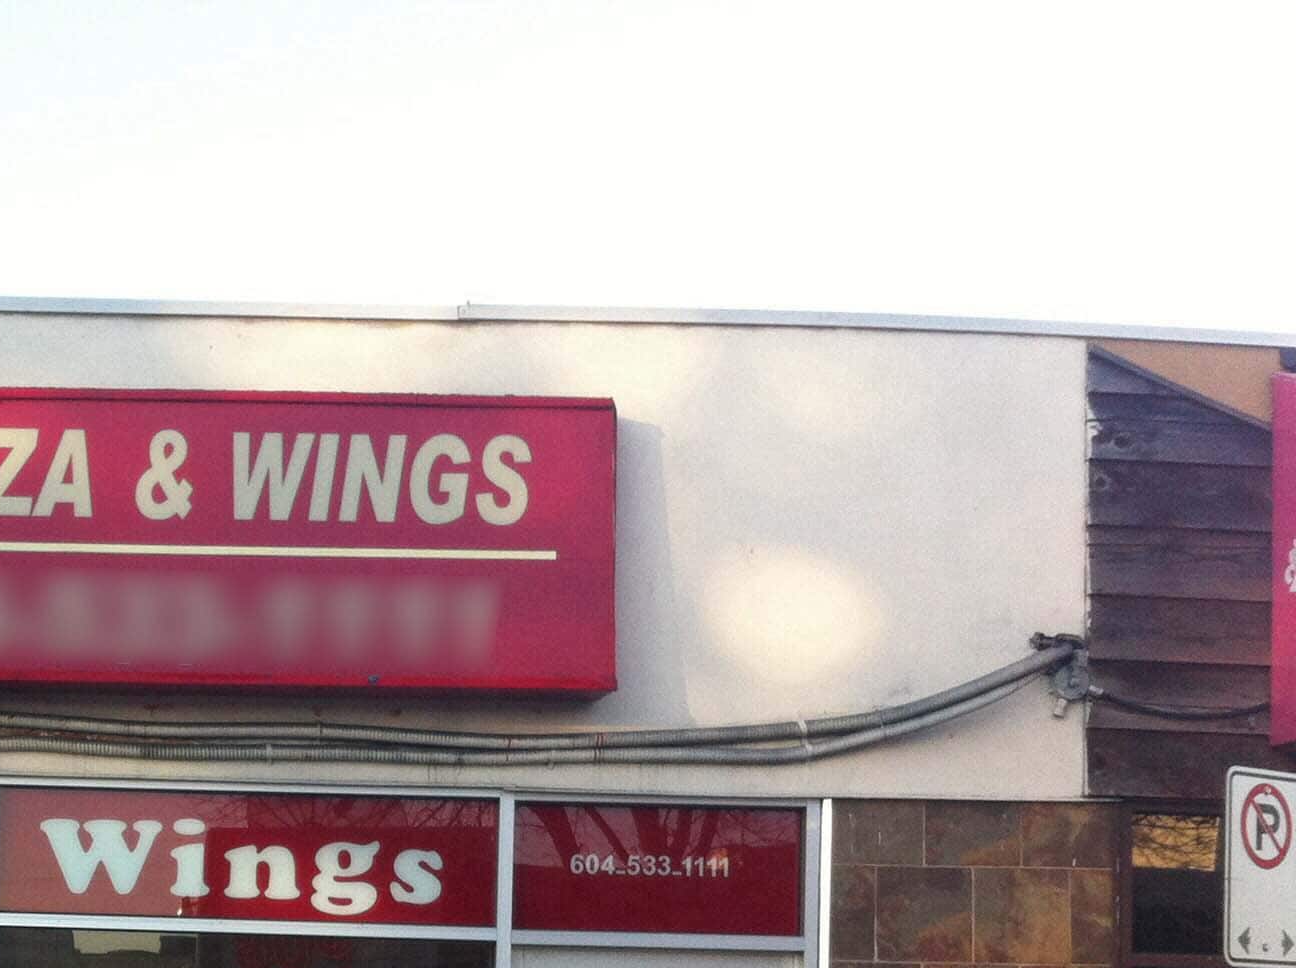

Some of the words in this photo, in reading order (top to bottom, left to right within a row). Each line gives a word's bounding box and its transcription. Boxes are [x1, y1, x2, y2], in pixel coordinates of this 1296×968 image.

[134, 428, 194, 521] &
[232, 431, 532, 526] WINGS
[39, 817, 444, 917] Wings
